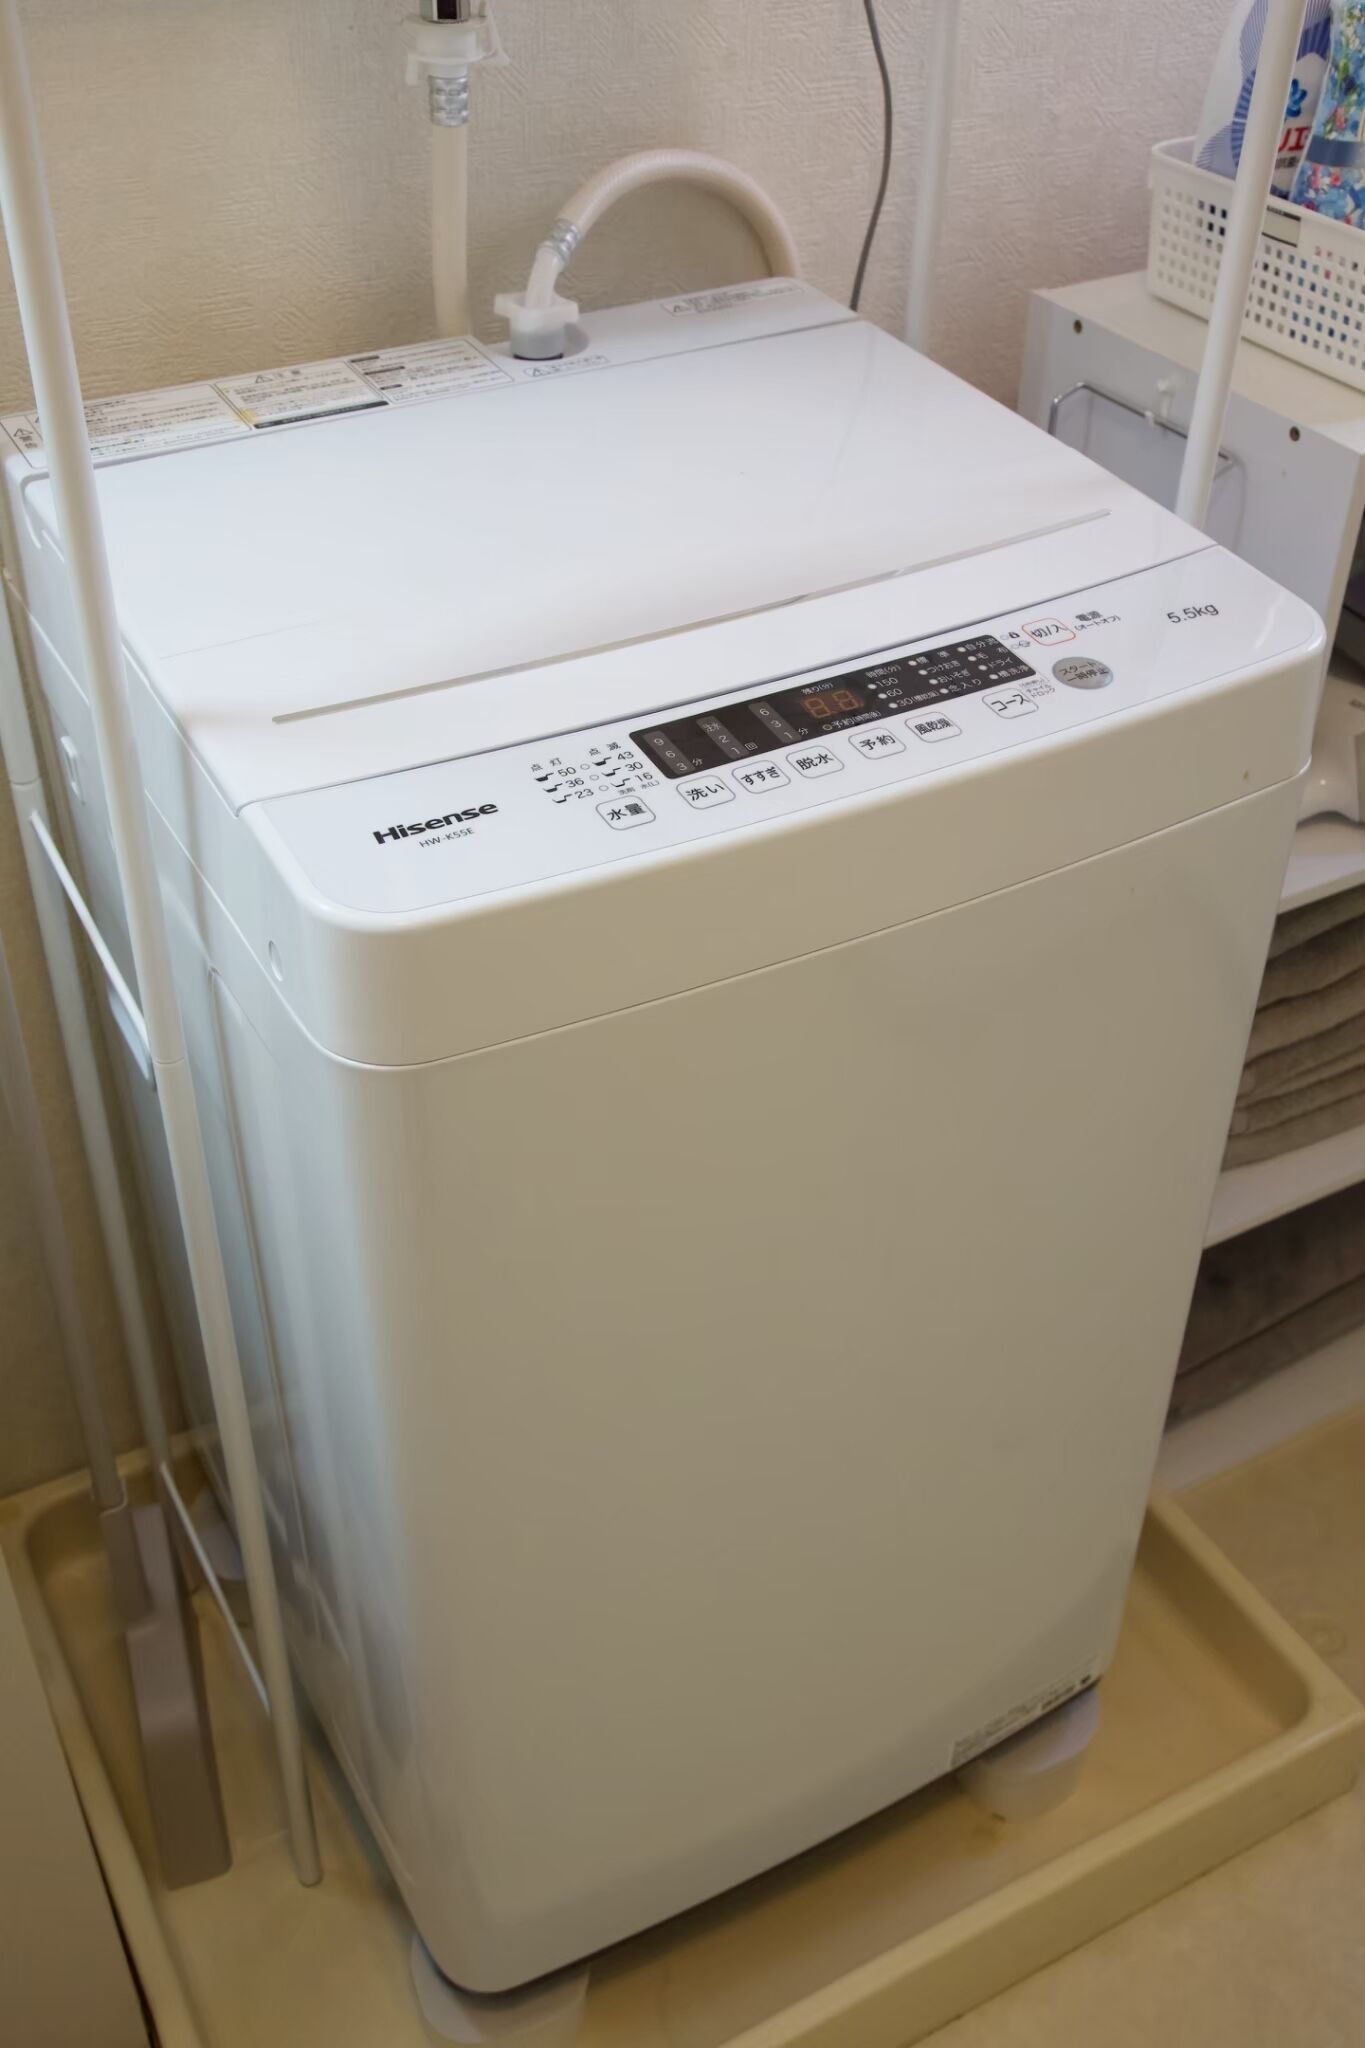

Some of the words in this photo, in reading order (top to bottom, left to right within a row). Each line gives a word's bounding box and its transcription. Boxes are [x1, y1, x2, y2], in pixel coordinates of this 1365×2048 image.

[1166, 604, 1219, 623] 5.5kg
[1030, 624, 1069, 638] 切/入
[987, 656, 1014, 669] ドライ
[1058, 661, 1098, 676] スタート
[875, 677, 899, 688] 150
[886, 688, 903, 697] 60
[990, 693, 1031, 712] コース
[759, 708, 770, 716] 6
[770, 720, 782, 728] 3
[653, 737, 665, 746] 9
[718, 735, 729, 744] 2
[858, 733, 896, 751] 予約
[744, 741, 758, 751] 回
[617, 751, 634, 760] 43
[665, 750, 676, 759] 6
[624, 761, 644, 772] 30
[676, 762, 688, 771] 3
[796, 752, 834, 771] 脱水
[557, 766, 577, 777] 50
[634, 772, 653, 782] 16
[740, 765, 781, 786] すすぎ
[565, 777, 585, 788] 36
[574, 788, 594, 799] 23
[685, 782, 726, 801] 洗い
[606, 803, 647, 821] 水量
[372, 803, 499, 845] Hisense
[419, 827, 475, 848] HW-K55E
